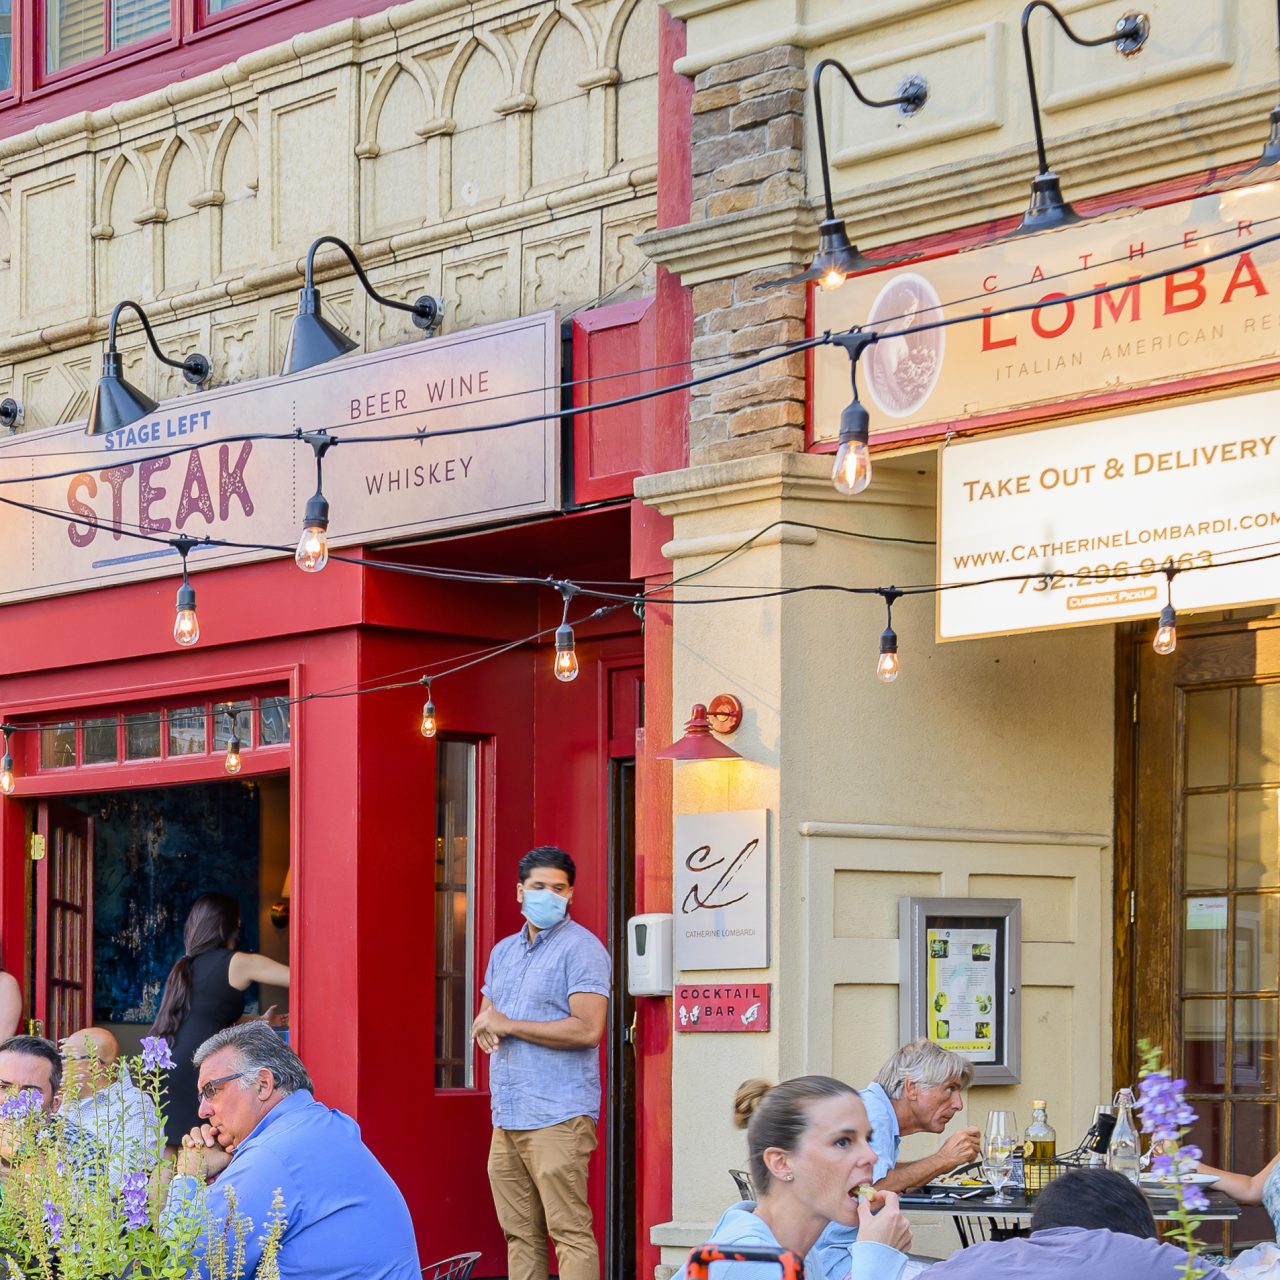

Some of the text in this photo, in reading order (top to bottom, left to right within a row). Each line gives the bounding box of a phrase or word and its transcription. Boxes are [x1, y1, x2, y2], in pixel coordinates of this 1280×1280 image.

[980, 251, 1269, 352] LOMBA
[995, 312, 1280, 382] ITALIAN AMERICAN RE
[349, 370, 490, 420] BEER WINE
[105, 411, 211, 451] STAGE LEFT
[365, 456, 473, 496] WHISKEY
[963, 436, 1277, 502] TAKE OUT & DELIVERY
[66, 439, 256, 547] STEAK
[1119, 589, 1155, 601] PICKUP
[685, 928, 756, 938] CATHERINE LOMBARDI
[680, 988, 760, 999] COCKTAIL
[704, 1006, 735, 1017] BAR
